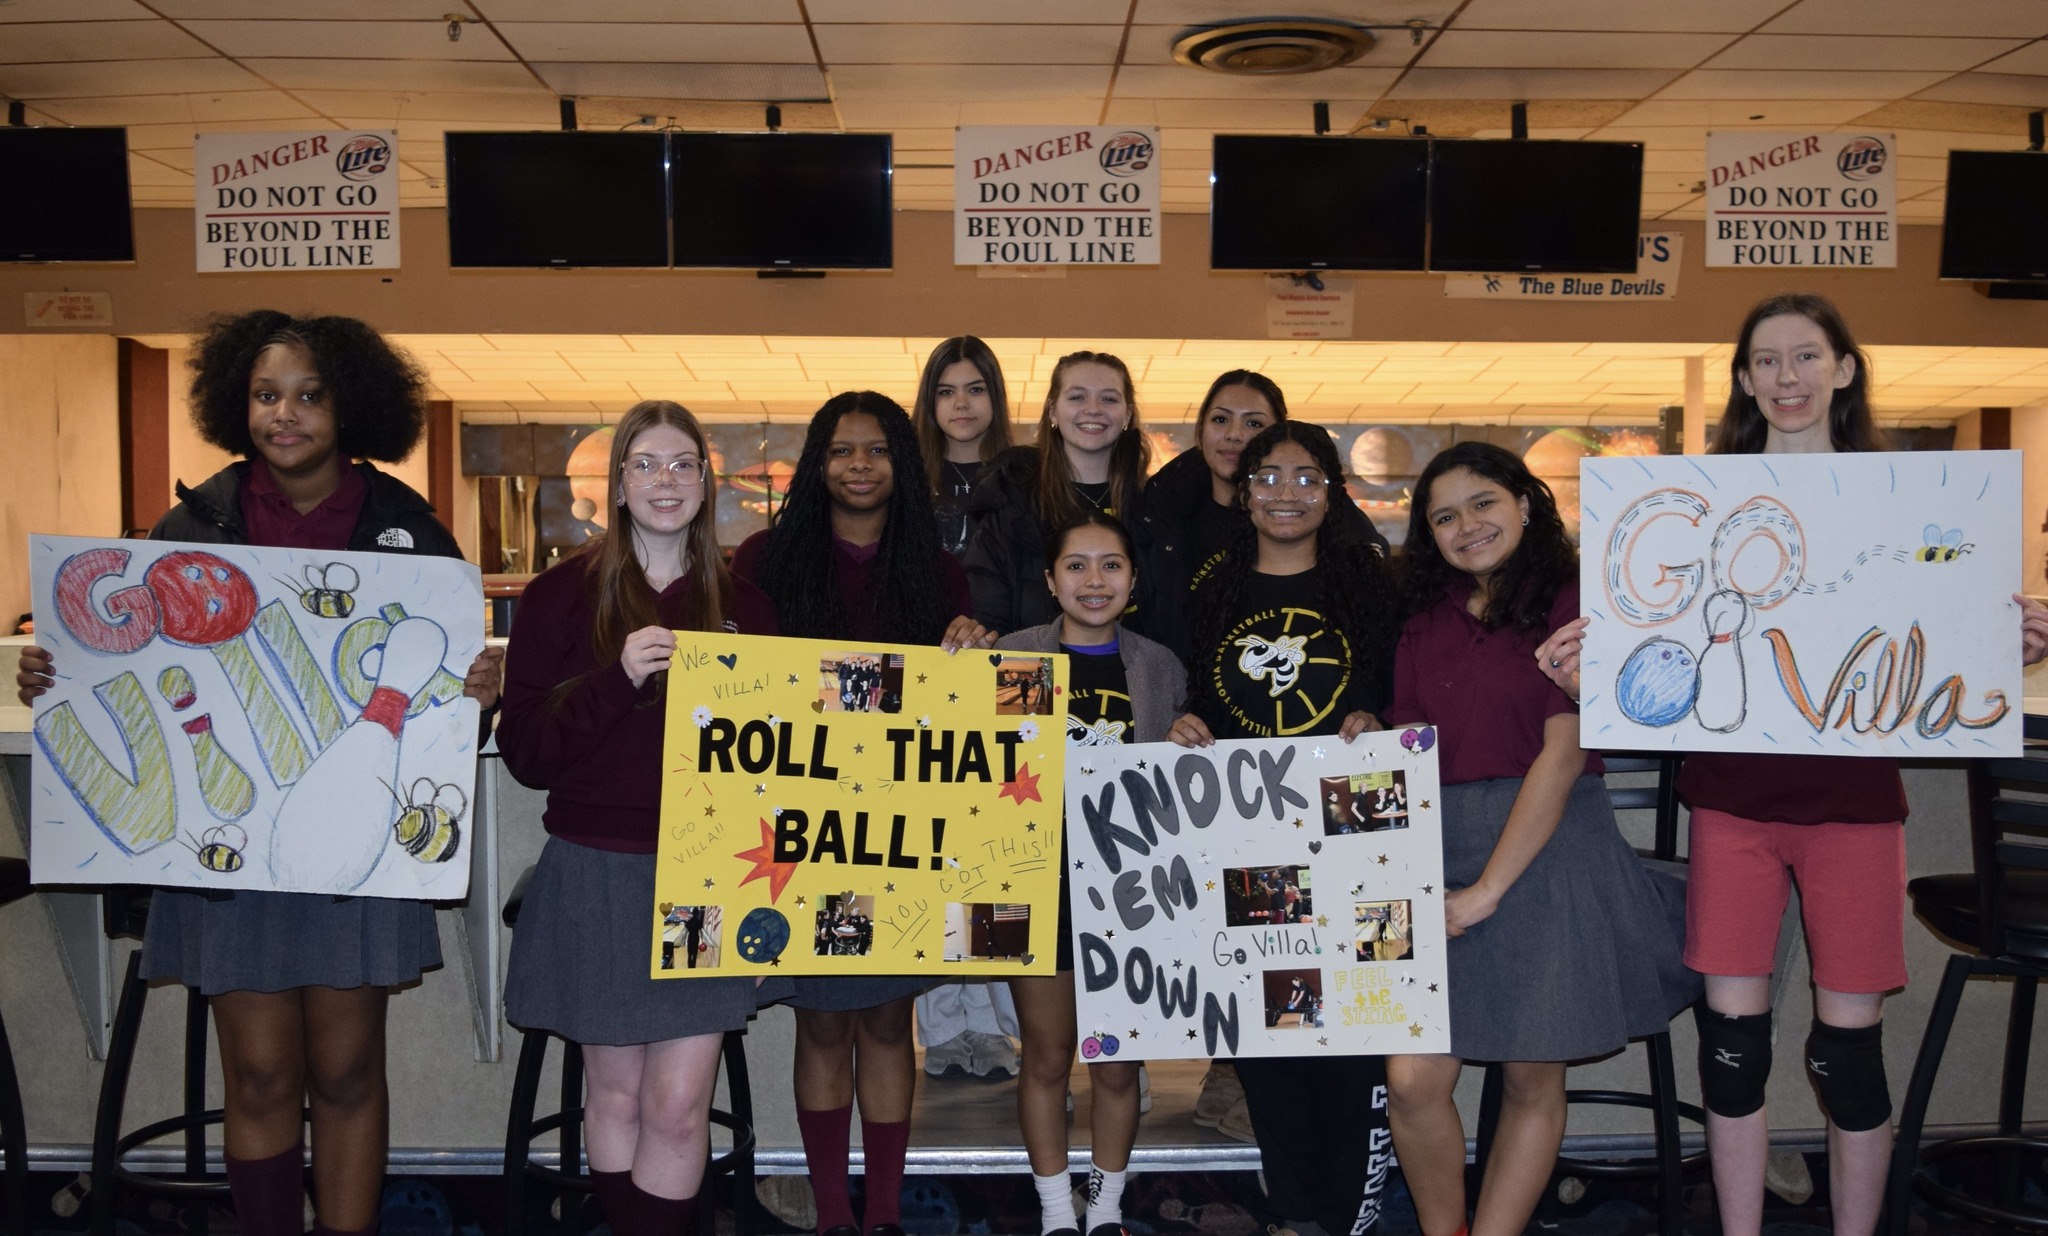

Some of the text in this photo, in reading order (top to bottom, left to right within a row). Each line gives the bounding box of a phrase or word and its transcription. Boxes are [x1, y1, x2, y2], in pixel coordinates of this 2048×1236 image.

[211, 135, 329, 186] DANGER
[341, 146, 388, 173] Lite
[973, 130, 1093, 179] DANGER
[1104, 143, 1151, 168] Lite
[1711, 135, 1822, 188] DANGER
[1841, 149, 1885, 172] Lite
[217, 185, 377, 208] DO NOT GO
[979, 183, 1140, 204] DO NOT GO
[1728, 186, 1878, 208] DO NOT GO
[206, 219, 390, 243] BEYOND THE
[967, 216, 1153, 237] BEYOND THE
[1717, 219, 1889, 241] BEYOND THE
[223, 245, 373, 268] FOUL LINE
[984, 242, 1135, 263] FOUL LINE
[1733, 245, 1873, 265] FOUL LINE
[1519, 277, 1665, 296] The Blue Devils
[1603, 487, 1808, 628] GO
[678, 644, 711, 671] We
[713, 673, 769, 699] VILLA!
[1760, 618, 2011, 739] Villa
[698, 716, 1025, 783] ROLL THAT
[1081, 744, 1309, 875] KNOCK
[671, 821, 695, 841] GO
[773, 808, 947, 871] BALL!
[879, 899, 928, 933] YOU
[939, 864, 985, 893] GOT
[1087, 854, 1198, 931] 'EM
[1212, 927, 1323, 967] Go Villa!
[1334, 966, 1393, 992] FEEL
[1078, 931, 1240, 1057] DOWN
[1354, 987, 1391, 1008] the
[1342, 1002, 1407, 1026] STING
